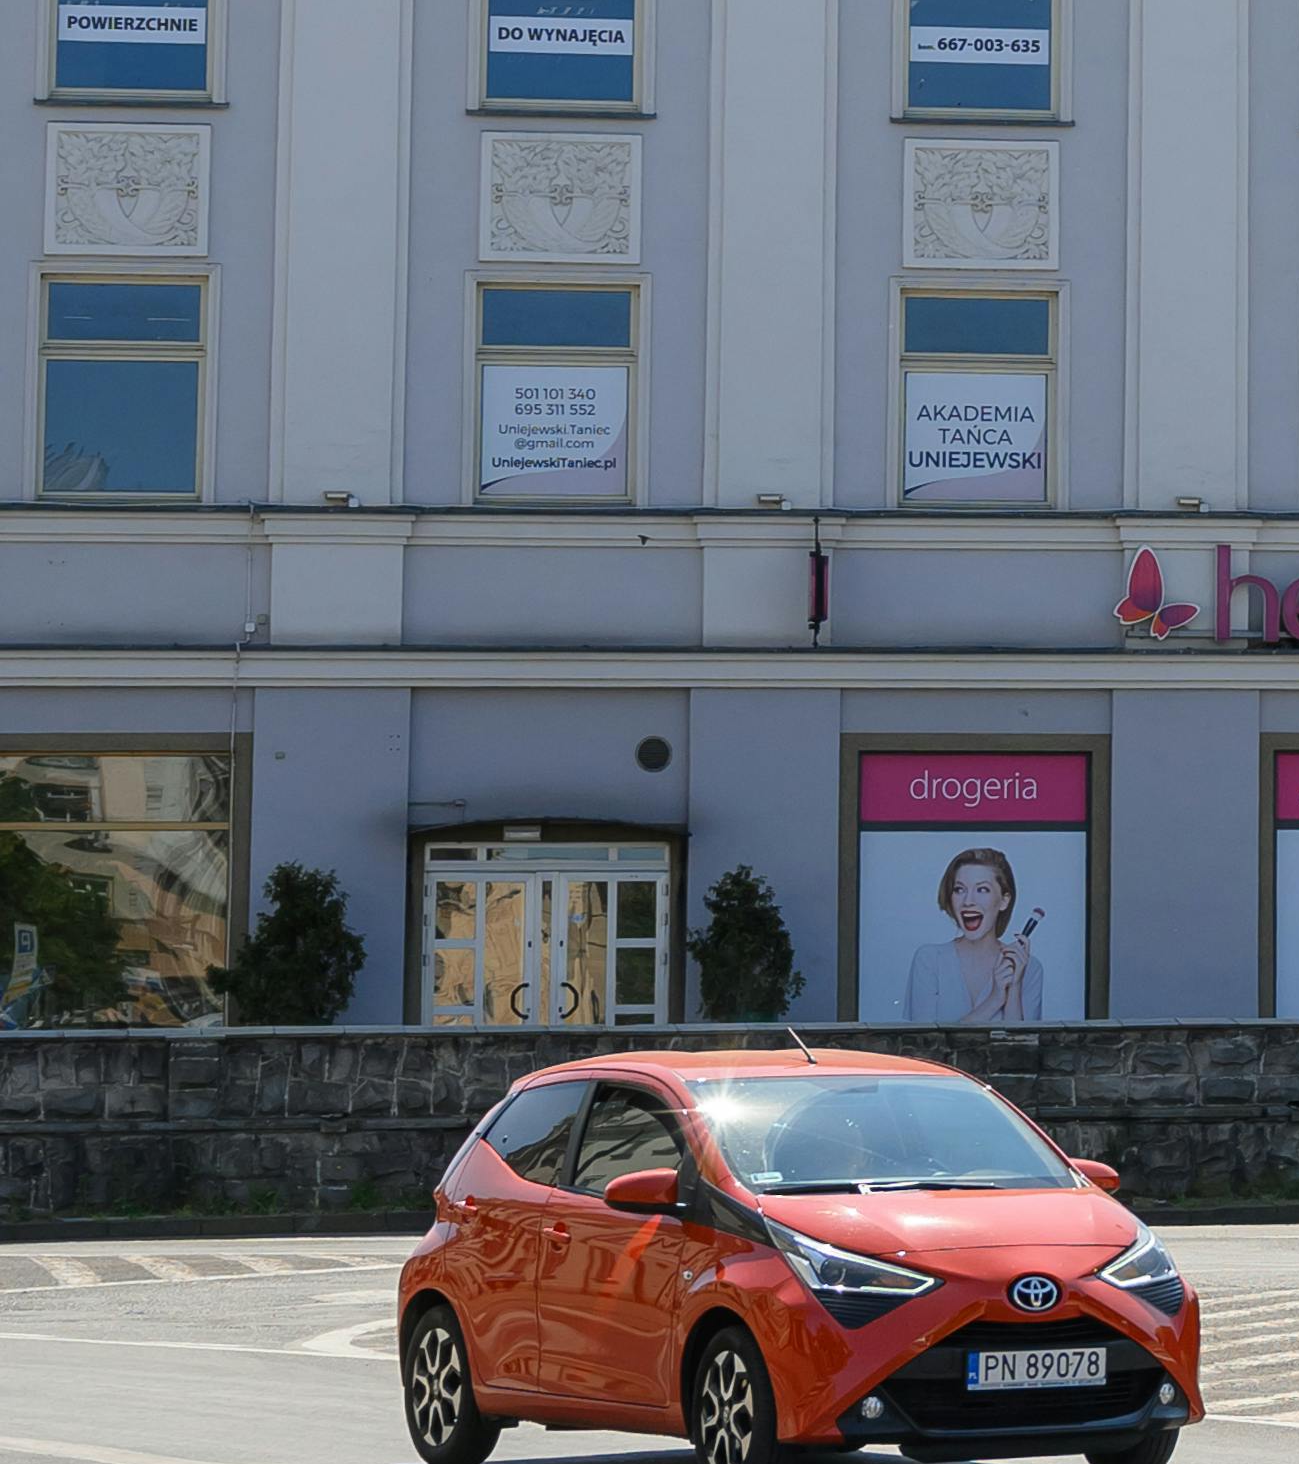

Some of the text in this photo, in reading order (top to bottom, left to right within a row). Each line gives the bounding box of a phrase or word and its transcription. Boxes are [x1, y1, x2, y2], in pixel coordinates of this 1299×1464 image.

[67, 15, 198, 32] POWIERZCHNIE
[498, 26, 625, 47] DO WYNAJĘCIA
[937, 37, 1040, 53] 667-003-635
[515, 387, 596, 401] 501 101 340
[515, 403, 596, 416] 695 311 552
[916, 404, 1035, 423] AKADEMIA
[514, 437, 595, 451] @gmail.com
[938, 424, 1013, 446] TAŃCA
[491, 456, 617, 471] UniejewskiTaniec.pl
[908, 450, 1042, 470] UNIEJEWSKI
[909, 769, 1038, 808] drogeria
[984, 1350, 1100, 1382] PN 89078
